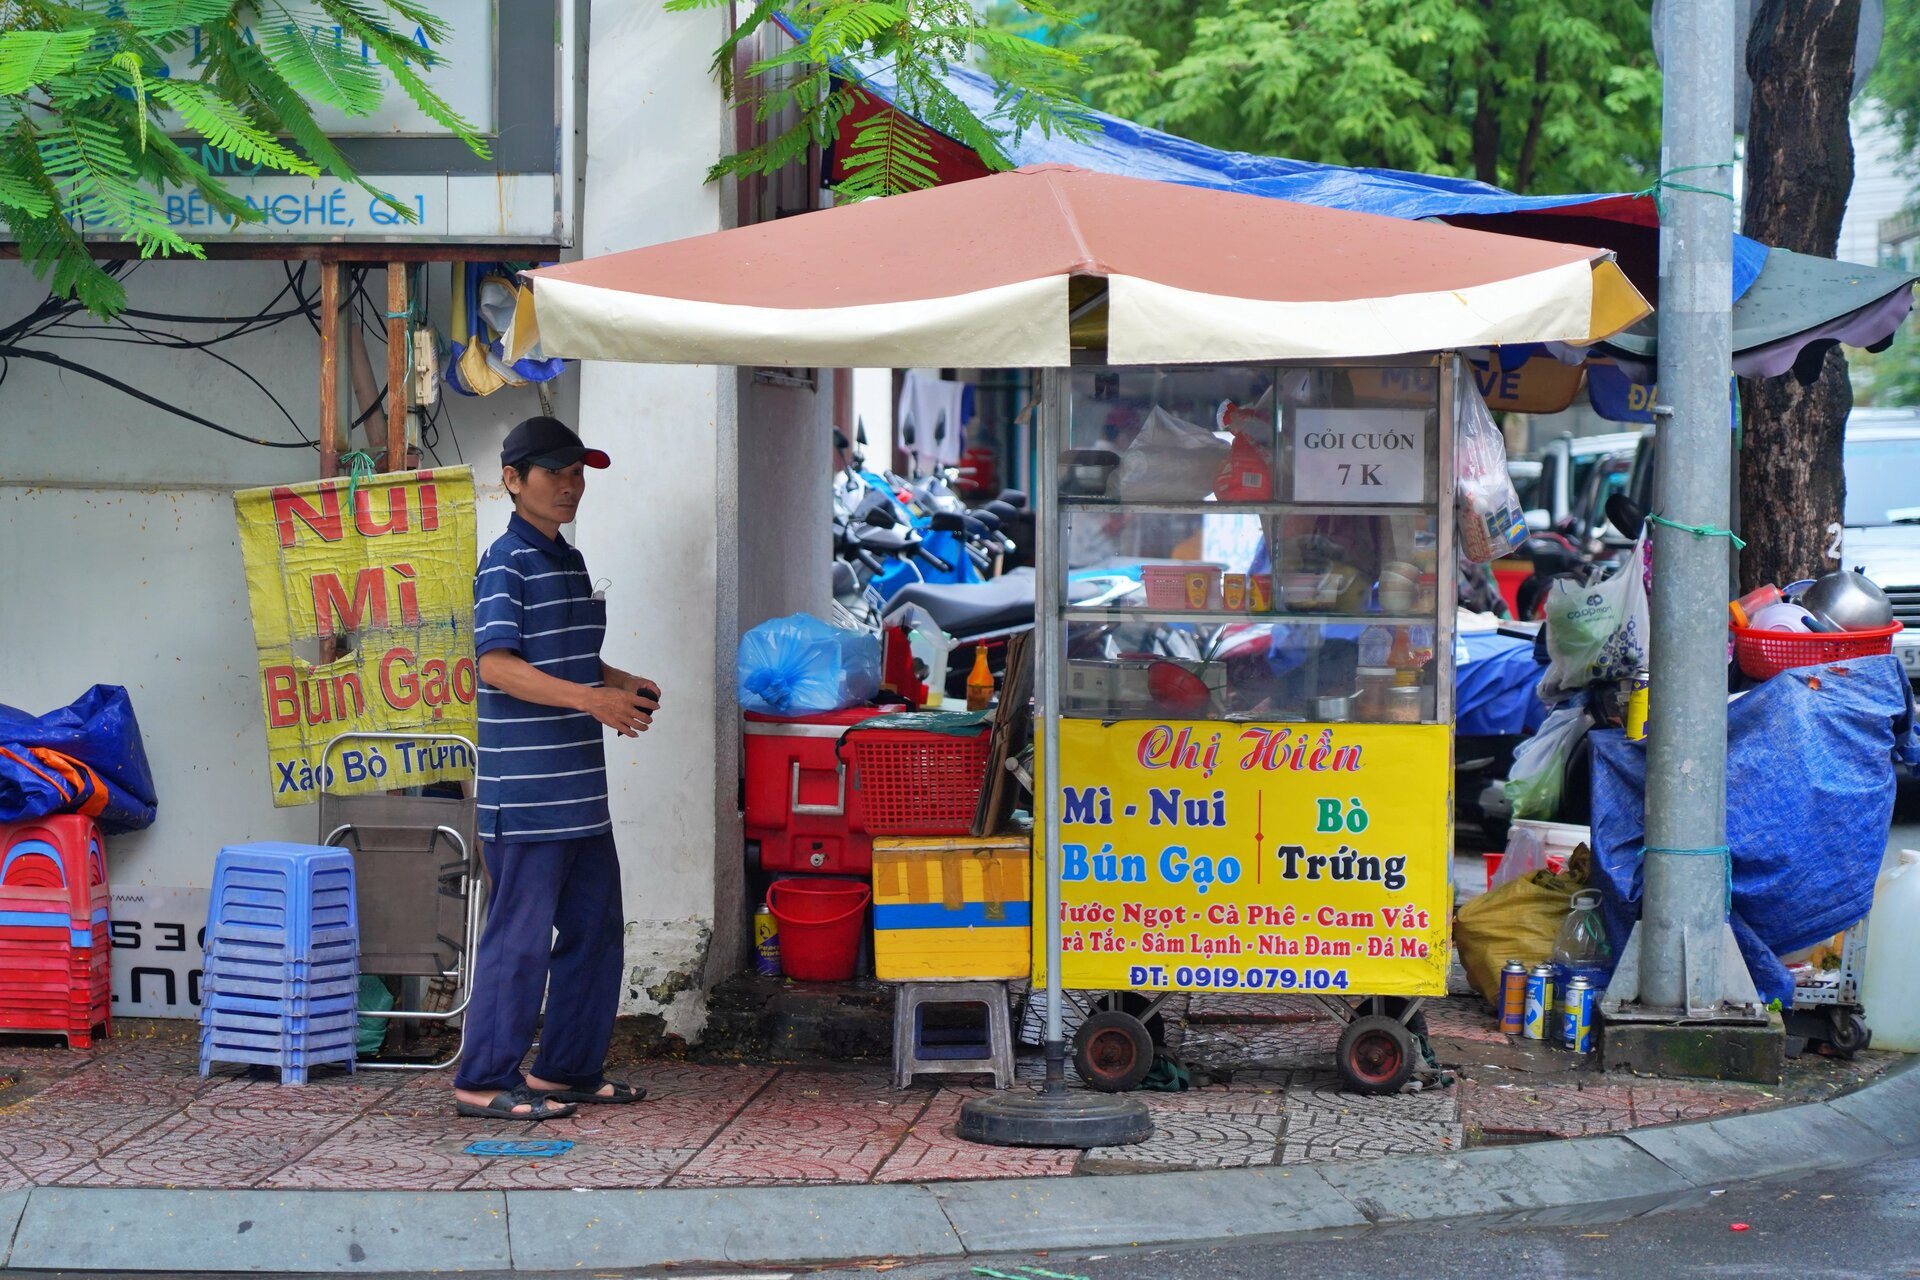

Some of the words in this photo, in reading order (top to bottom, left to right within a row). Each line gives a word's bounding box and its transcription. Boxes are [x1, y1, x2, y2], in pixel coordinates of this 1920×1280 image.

[1303, 428, 1345, 449] GỎI
[1351, 428, 1416, 450] CUỐN
[1337, 464, 1352, 486] 7
[1360, 464, 1384, 486] K
[271, 470, 439, 548] Nui
[310, 563, 421, 639] Mì
[265, 664, 365, 729] Bún
[379, 646, 477, 721] Gạo
[275, 759, 334, 794] Xào
[341, 746, 387, 783] Bò
[1136, 724, 1223, 779] Chị
[1238, 726, 1367, 772] Hiền
[1062, 786, 1113, 825] Mì
[1148, 787, 1227, 827] Nui
[1316, 797, 1369, 834] Bò
[1060, 843, 1148, 883] Bún
[1158, 844, 1242, 894] Gạo
[1276, 844, 1407, 891] Trứng
[1122, 902, 1186, 929] Ngọt
[1207, 903, 1240, 925] Cà
[1247, 905, 1296, 926] Phê
[1317, 906, 1374, 928] Cam
[1381, 904, 1429, 929] Vắt
[1061, 931, 1084, 951] rà
[1089, 928, 1126, 951] Tắc
[1142, 932, 1185, 953] Sâm
[1190, 933, 1242, 960] Lạnh
[1258, 935, 1299, 955] Nha
[1304, 935, 1351, 956] Đam
[1367, 936, 1395, 957] Đá
[1400, 937, 1429, 958] Me
[1129, 966, 1169, 986] ĐT:
[1175, 967, 1350, 990] 0919.079.104
